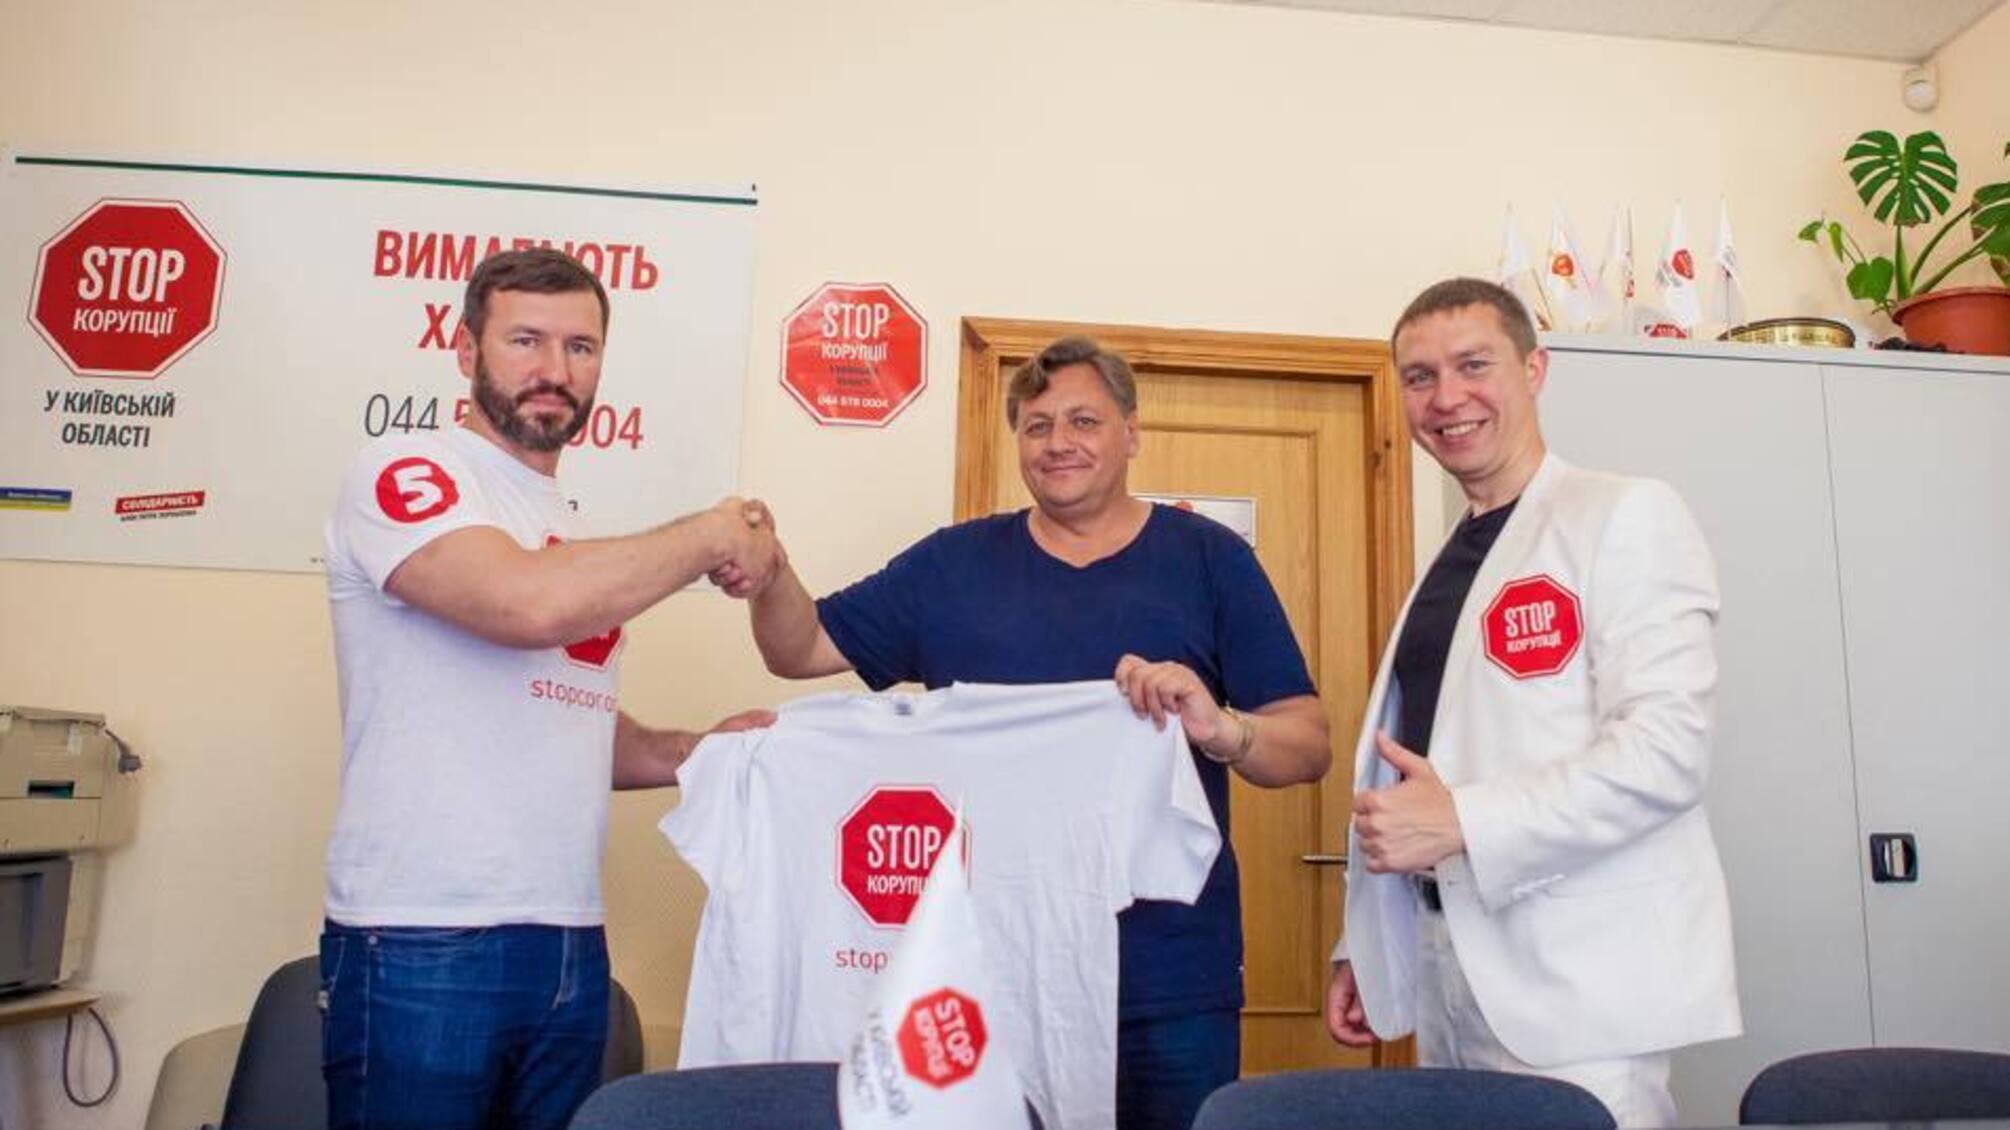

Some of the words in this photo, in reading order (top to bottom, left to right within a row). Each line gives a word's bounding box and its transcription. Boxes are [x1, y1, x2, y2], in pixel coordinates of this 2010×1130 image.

[78, 246, 185, 302] STOP
[73, 308, 177, 337] КОРУПЦІЇ
[822, 301, 890, 339] STOP
[44, 390, 59, 412] У
[63, 389, 176, 417] КИЇВСЬКІЙ
[364, 394, 439, 437] 044
[62, 423, 150, 447] ОБЛАСТІ
[393, 464, 443, 515] 5
[1504, 600, 1557, 638] STOP
[867, 824, 942, 870] STOP
[933, 996, 976, 1067] STOP
